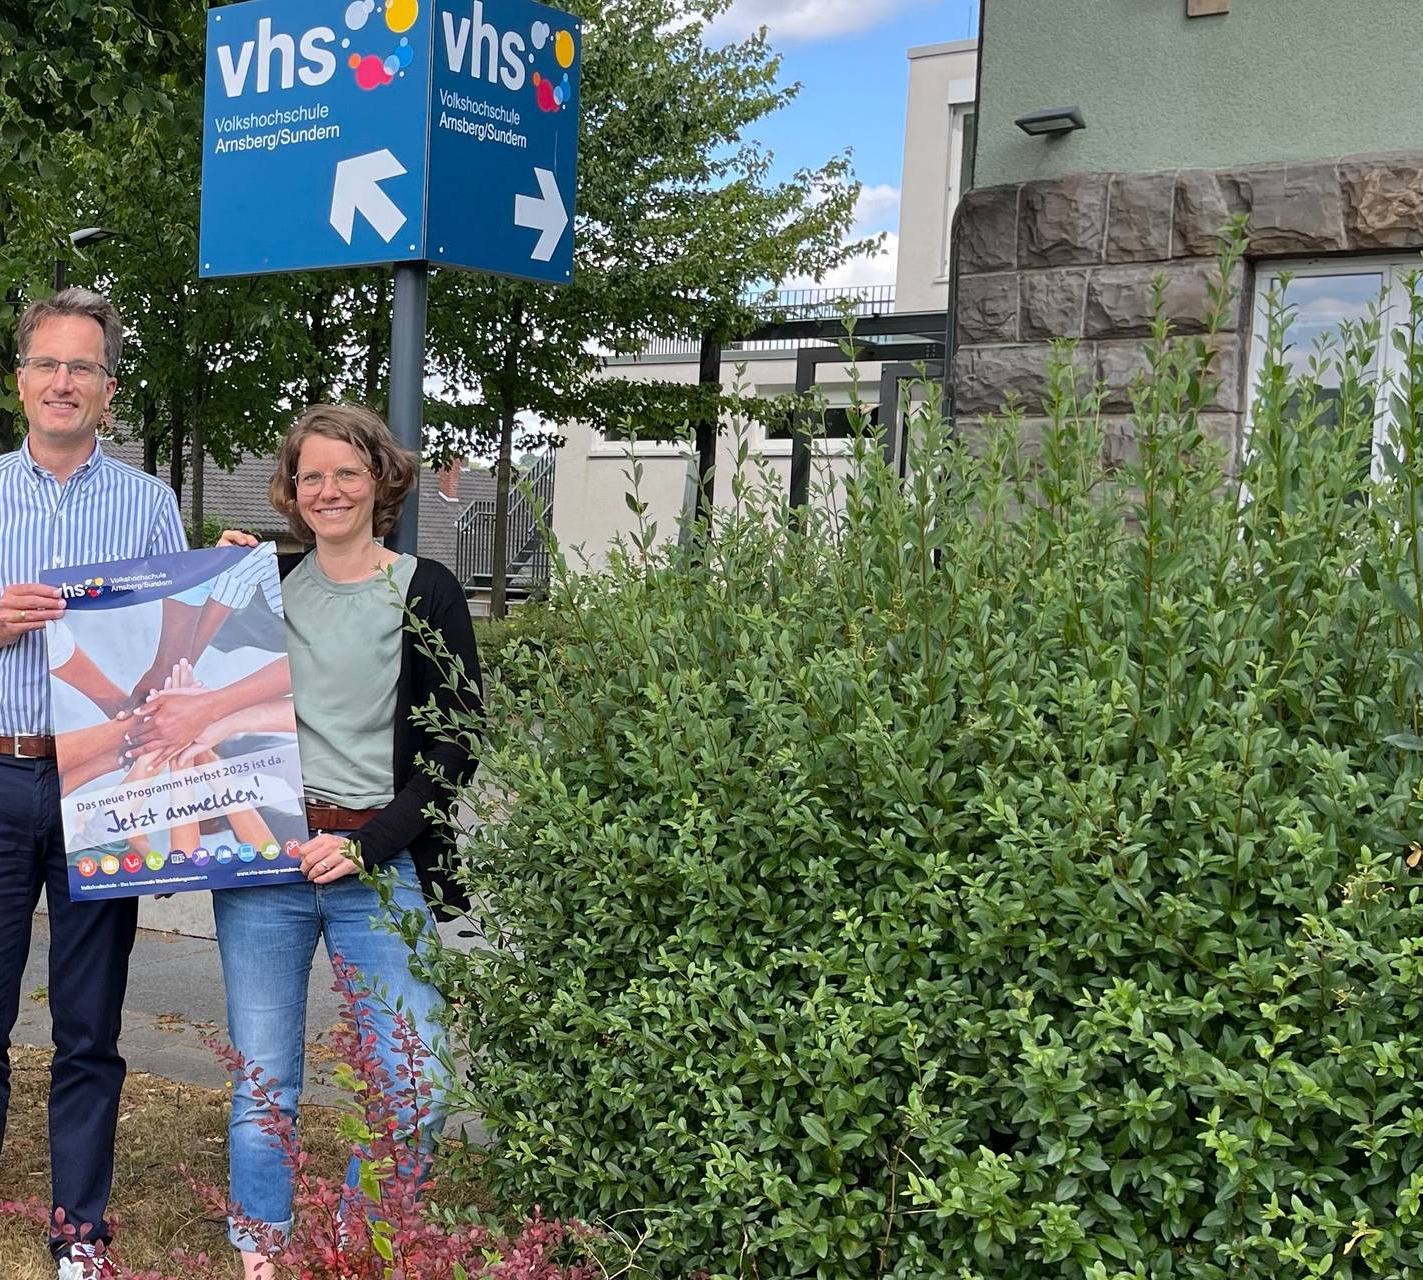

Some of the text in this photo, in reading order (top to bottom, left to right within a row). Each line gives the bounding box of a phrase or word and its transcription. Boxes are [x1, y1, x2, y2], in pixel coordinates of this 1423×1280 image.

[216, 17, 337, 98] vhs
[442, 0, 526, 92] vhs
[215, 103, 329, 133] Volkshochschule
[439, 88, 521, 126] Volkshochschule
[215, 123, 340, 154] Arnsberg/Sundern
[439, 113, 527, 149] Arnsberg/Sundern
[110, 572, 167, 584] Volkshochschule
[111, 579, 173, 592] Arnsberg/Sundern
[77, 800, 96, 813] Das
[99, 794, 125, 808] neue
[126, 779, 183, 801] Programm
[184, 769, 222, 786] Herbst
[223, 763, 250, 777] 2025
[252, 759, 266, 770] ist
[104, 775, 265, 834] Jetzt anmelden!
